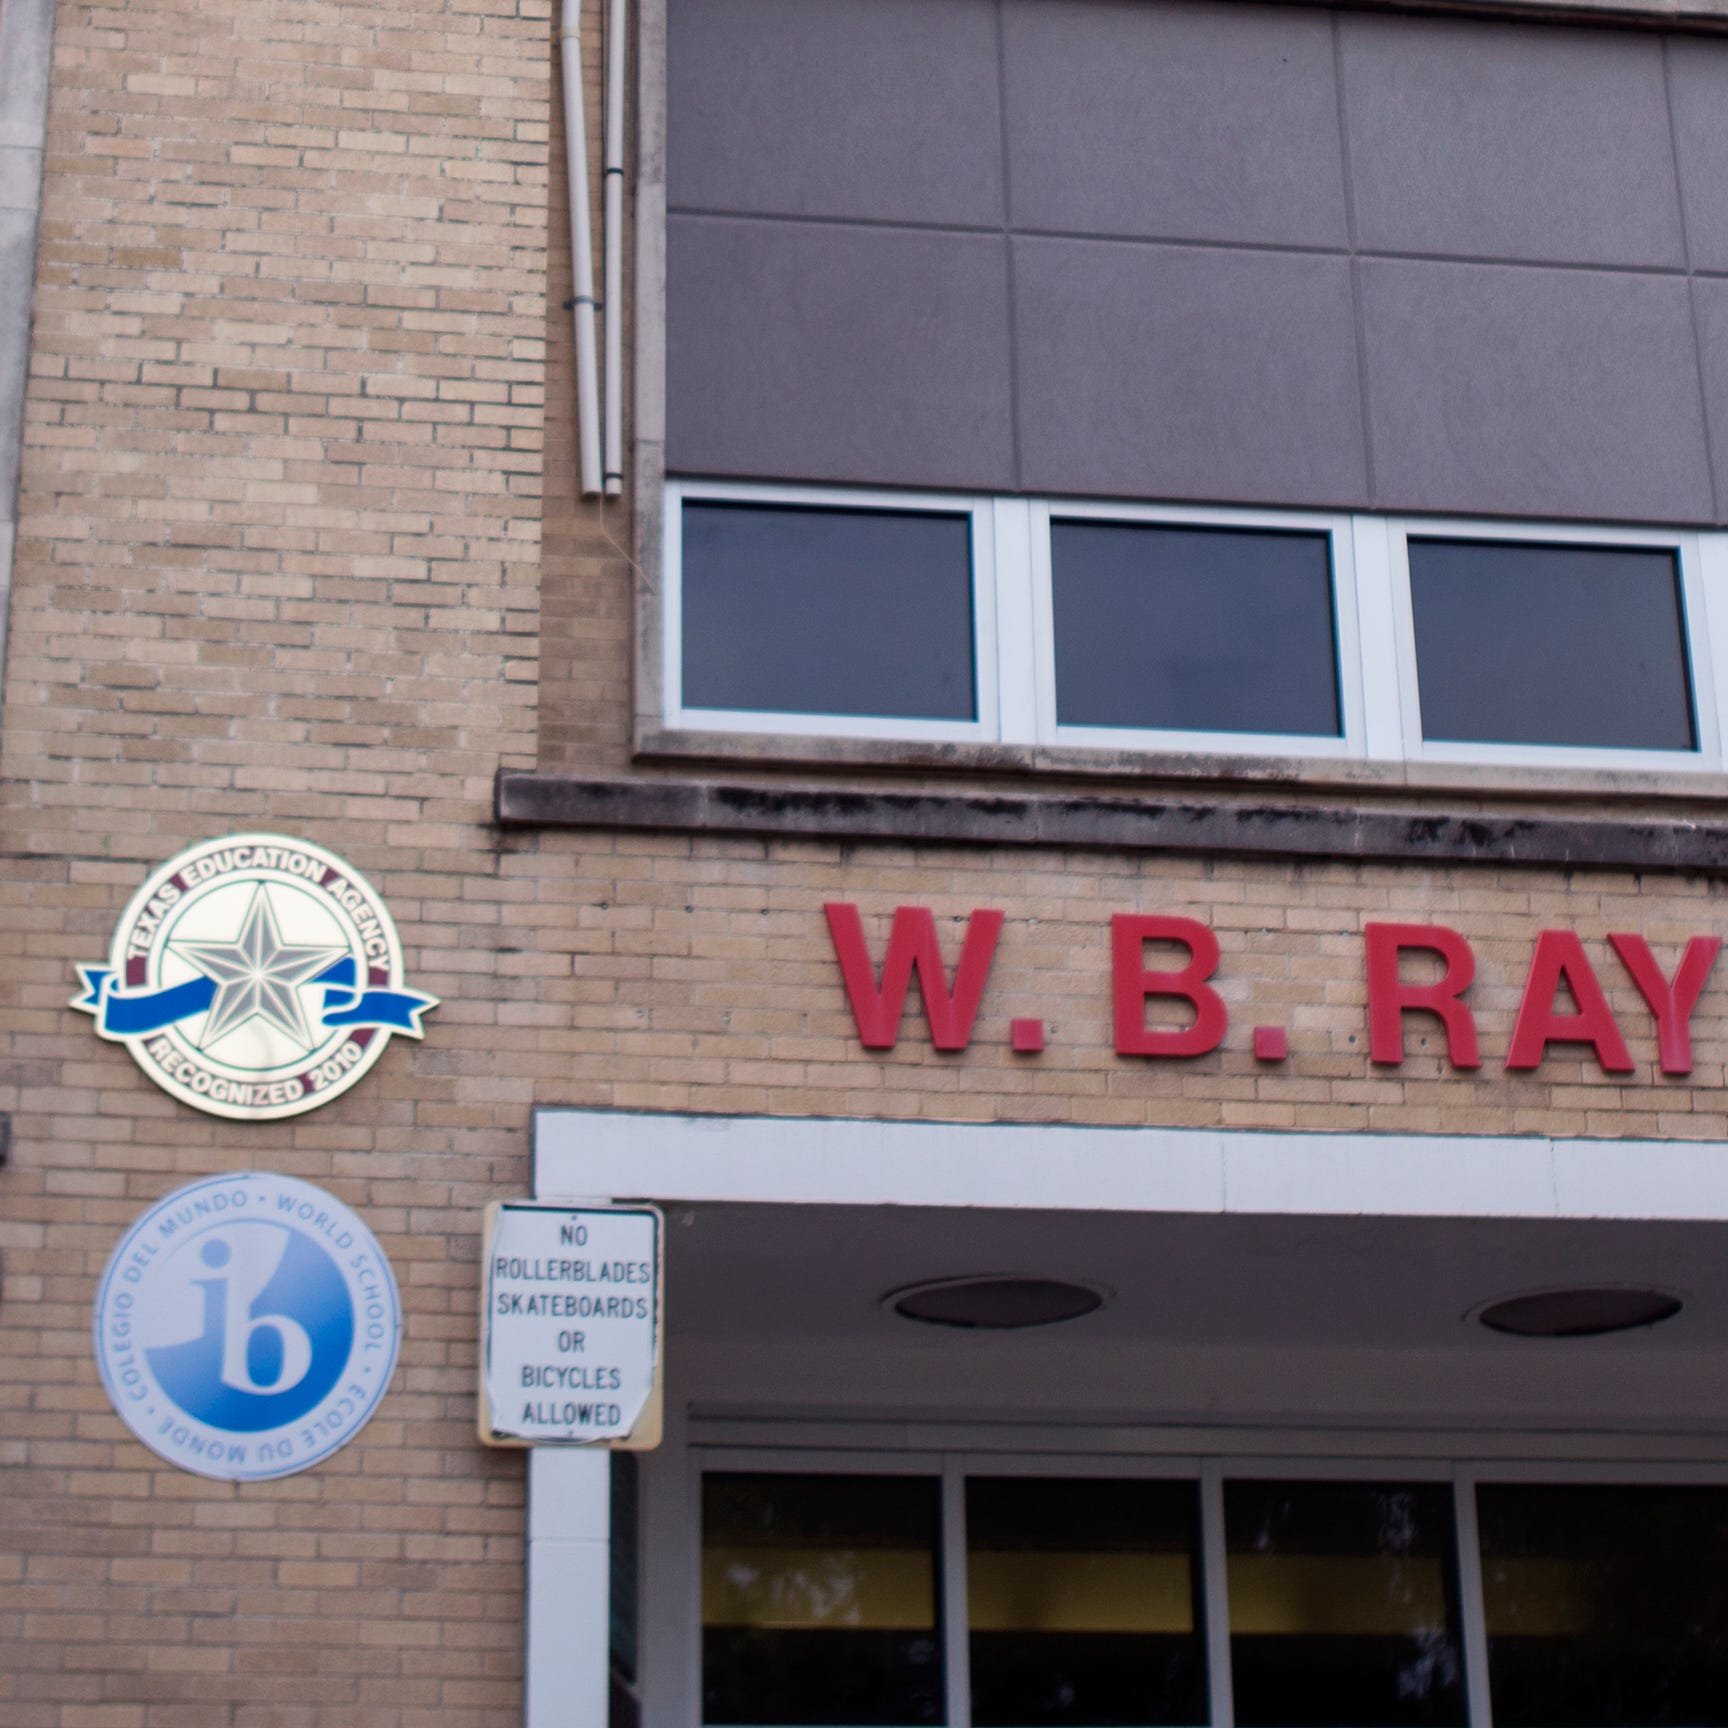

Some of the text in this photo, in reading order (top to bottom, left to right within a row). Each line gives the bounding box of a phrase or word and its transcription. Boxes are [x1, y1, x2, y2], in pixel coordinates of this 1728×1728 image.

[127, 846, 390, 971] TEXAS EDUCATION AGENCY
[822, 901, 1046, 1053] W.
[1110, 912, 1287, 1064] B.
[1364, 920, 1724, 1074] RAY
[149, 1036, 363, 1105] RECOGNIZED 2010
[560, 1225, 589, 1247] NO
[276, 1192, 386, 1353] WORLD SCHOOL
[495, 1257, 651, 1284] ROLLERBLADES
[111, 1189, 248, 1402] COLEGIO DEL MUNDO
[496, 1293, 649, 1320] SKATEBOARDS
[557, 1330, 586, 1353] OR
[521, 1365, 622, 1390] BICYCLES
[157, 1382, 367, 1463] ECOLE DU MONDE
[522, 1401, 622, 1427] ALLOWED
